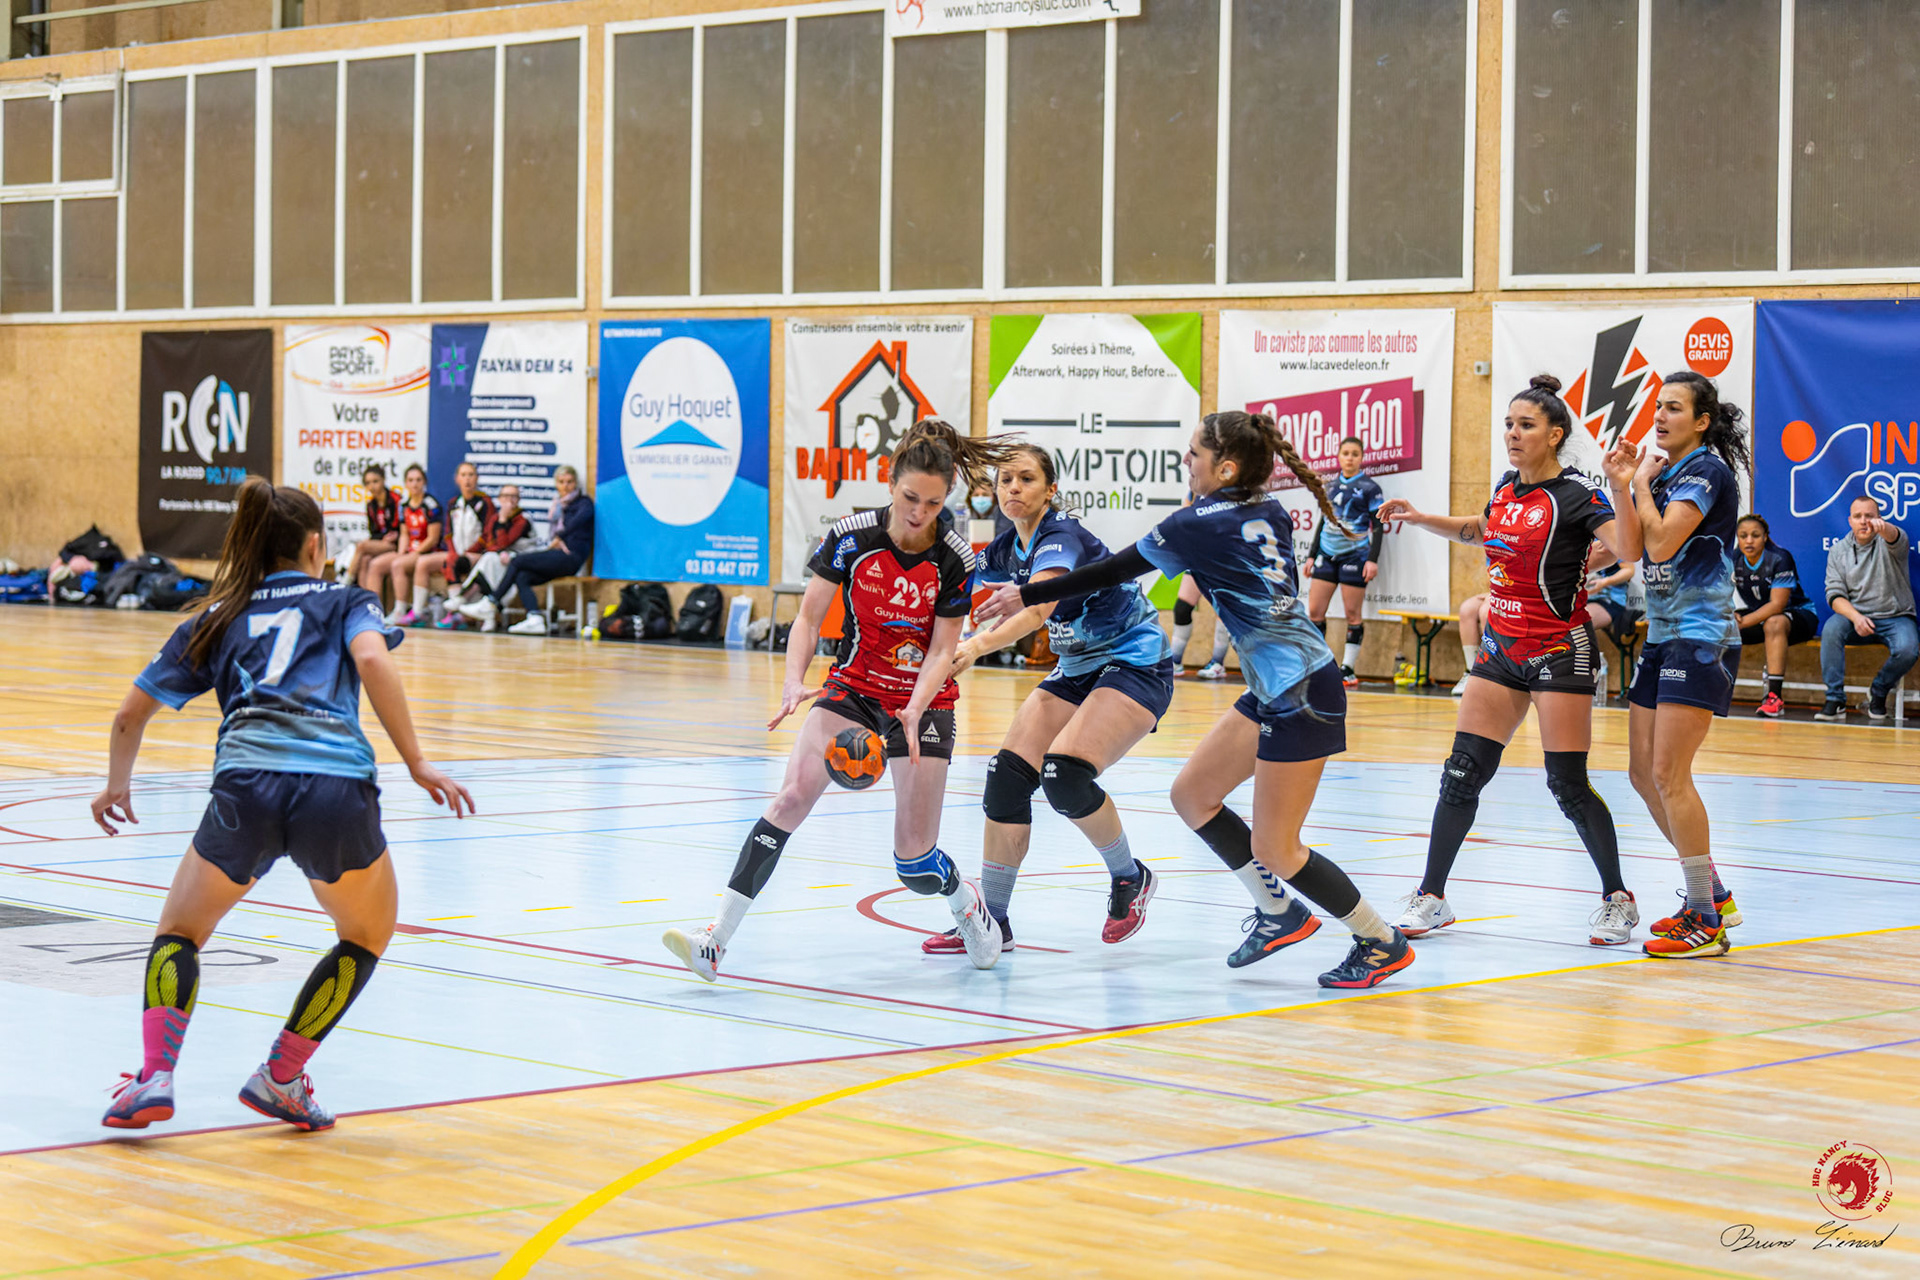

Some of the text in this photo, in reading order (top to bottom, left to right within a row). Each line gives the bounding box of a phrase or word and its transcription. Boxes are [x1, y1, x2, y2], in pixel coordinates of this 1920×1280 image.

[791, 321, 966, 334] Construisons ensemble votre avenir
[1051, 343, 1135, 357] Soirées à Thème,
[1254, 330, 1417, 356] Un caviste pas comme les autres
[1689, 333, 1729, 349] DEVIS
[329, 346, 365, 359] PAYS
[1688, 350, 1729, 361] GRATUIT
[480, 359, 573, 374] RAYAN DEM 54
[1012, 365, 1065, 379] Afterwork,
[1068, 365, 1100, 379] Happy
[1102, 365, 1129, 379] Hour,
[1280, 358, 1390, 371] www.lacavedeleon.fr
[333, 402, 379, 422] Votre
[629, 393, 732, 423] Guy Hoquet
[1080, 413, 1103, 434] LE
[1324, 427, 1340, 457] de
[1341, 388, 1403, 451] Léon
[299, 430, 417, 450] PARTENAIRE
[314, 457, 333, 476] de
[629, 454, 733, 466] L'IMMOBILIER GARANTI
[1055, 448, 1182, 483] MPTOIR
[1052, 486, 1143, 518] ampanile
[1494, 530, 1520, 544] Hoquet
[1241, 518, 1288, 584] 3
[685, 559, 759, 577] 03 83 447 077
[866, 570, 884, 579] SELECT
[874, 606, 930, 625] Guy Hoquet
[247, 607, 305, 687] 7
[920, 735, 941, 744] SELECT
